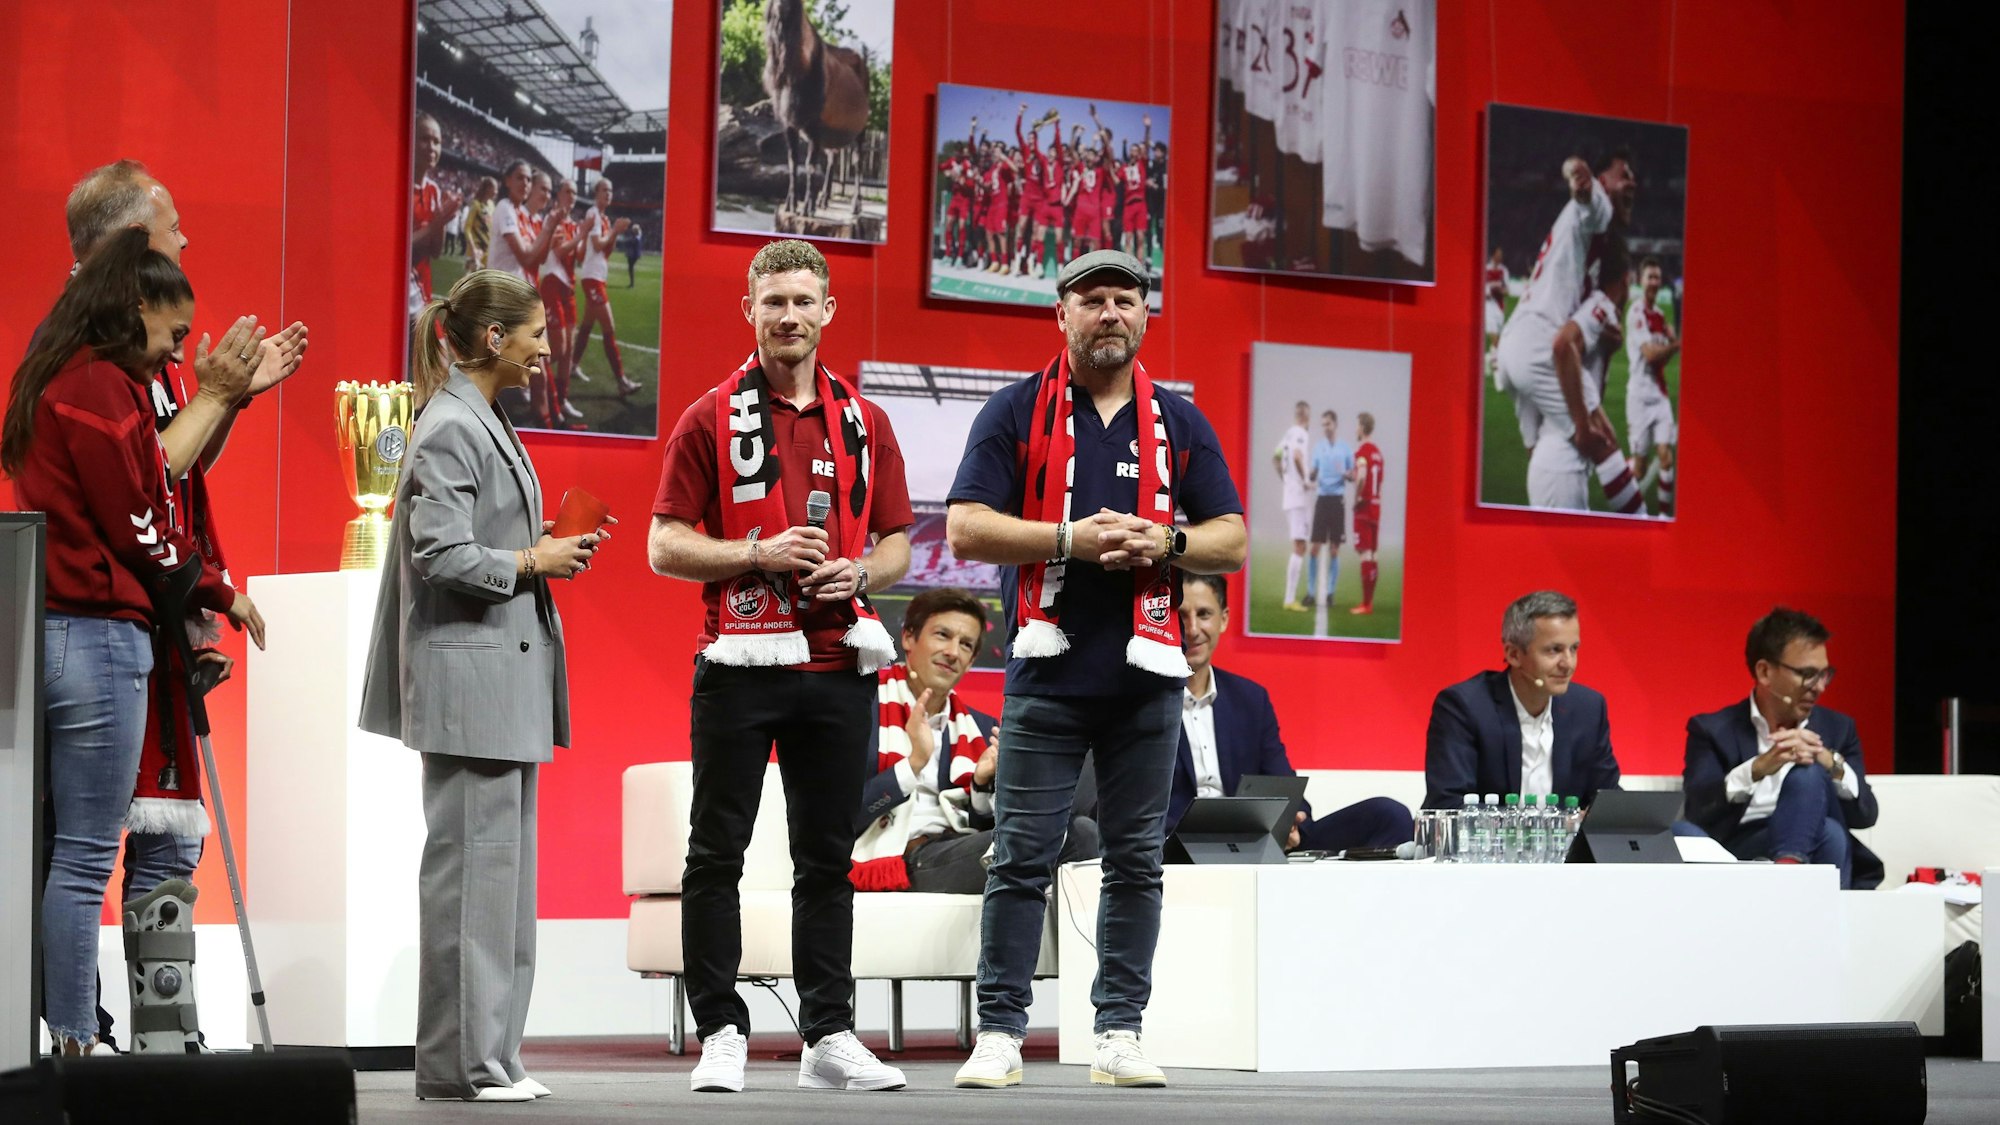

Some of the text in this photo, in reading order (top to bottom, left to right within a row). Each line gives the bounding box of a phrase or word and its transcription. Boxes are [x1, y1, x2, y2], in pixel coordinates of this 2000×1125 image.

[729, 388, 766, 504] ICH
[812, 458, 835, 478] RE
[1115, 461, 1140, 478] RE
[738, 600, 758, 612] KÖLN
[1157, 597, 1169, 607] FC
[724, 620, 761, 630] SPÜRBAR
